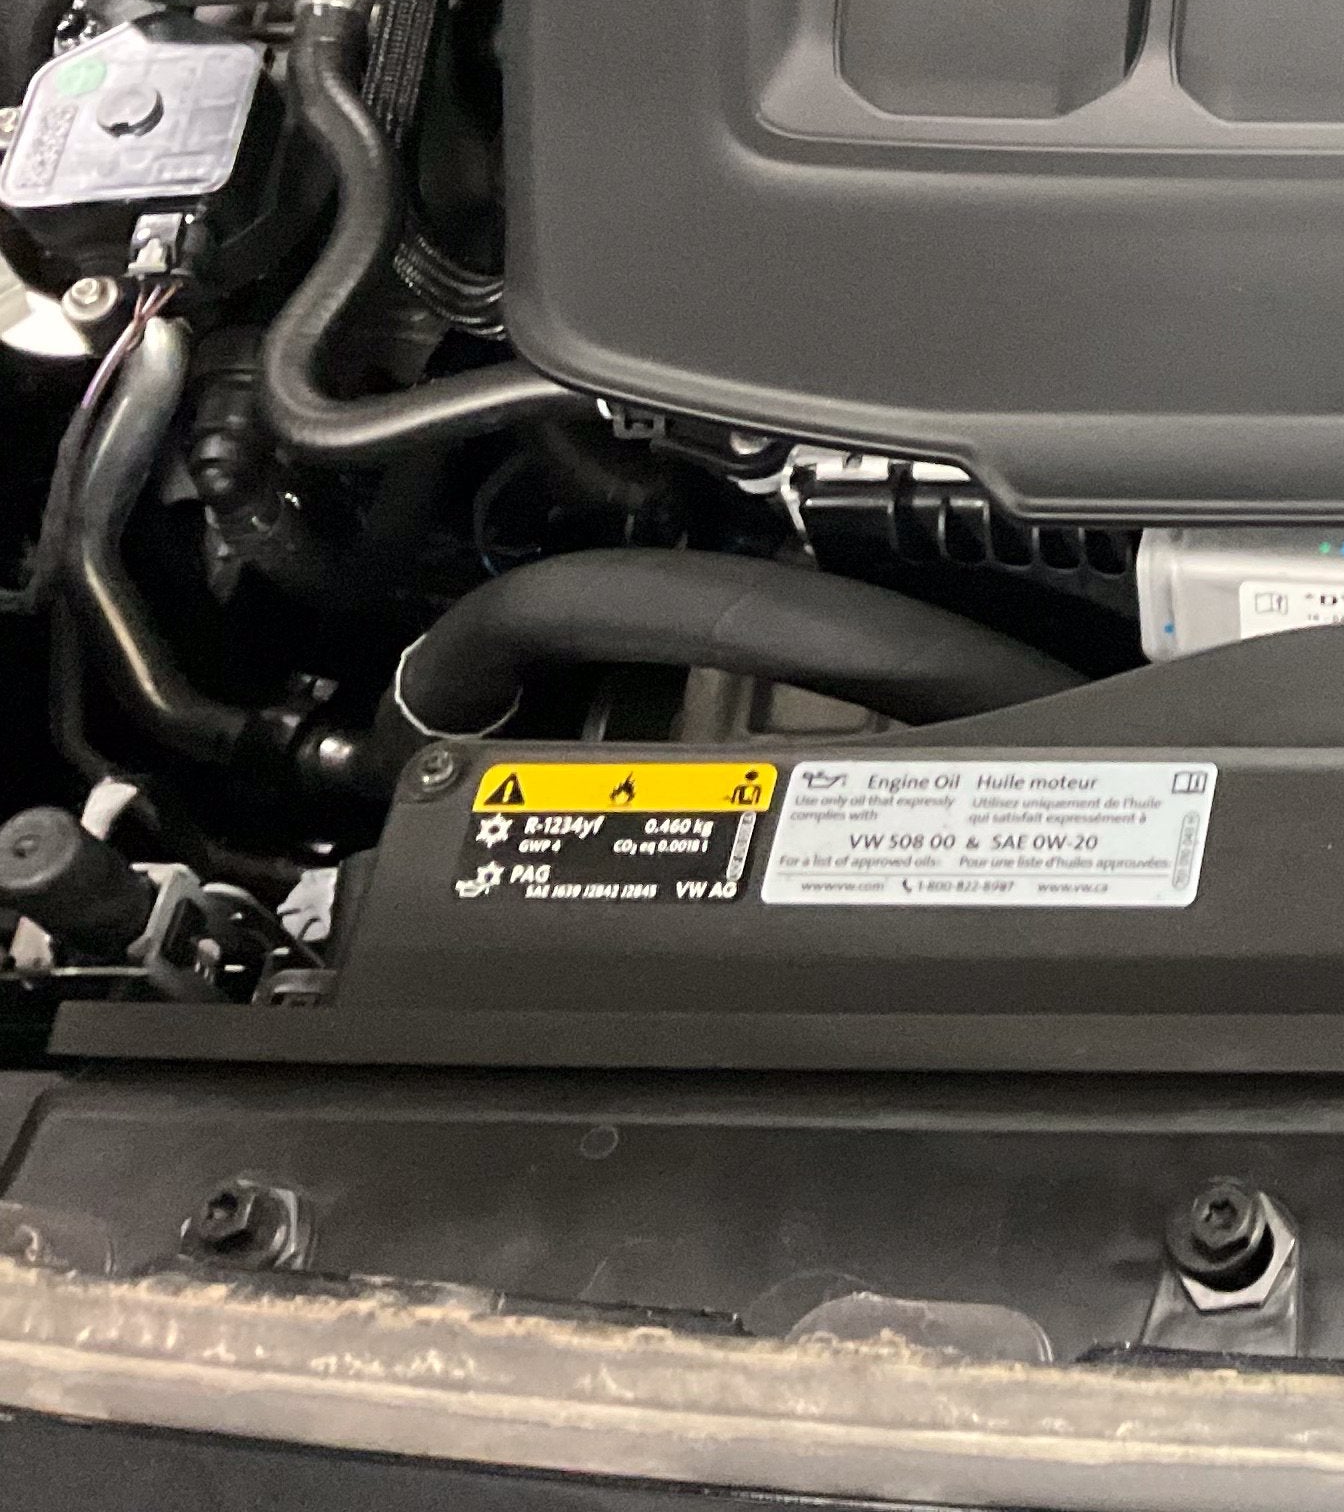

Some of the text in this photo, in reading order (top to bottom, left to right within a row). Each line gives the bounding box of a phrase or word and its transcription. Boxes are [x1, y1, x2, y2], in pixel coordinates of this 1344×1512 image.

[868, 774, 1098, 793] Engine Oil Huile moteur
[795, 795, 955, 809] Use only oil that expressly
[1022, 798, 1100, 812] uniquement
[1104, 797, 1120, 809] de
[1123, 797, 1161, 809] l'huile
[790, 810, 877, 823] complies with
[969, 813, 989, 825] qui
[992, 812, 1042, 823] satisfait
[1046, 813, 1135, 825] expressément
[524, 815, 605, 840] R-1234yf
[693, 818, 714, 838] kg
[519, 839, 551, 853] GWP
[850, 833, 1098, 850] VW 508 00 & SAE 0W-20
[779, 854, 799, 866] For
[802, 857, 810, 866] a
[813, 854, 832, 866] list
[835, 854, 849, 866] of
[851, 854, 911, 869] approved
[960, 856, 988, 867] Pour
[991, 858, 1014, 867] une
[1017, 856, 1043, 867] liste
[1045, 855, 1093, 867] d'huiles
[510, 864, 551, 883] PAG
[676, 881, 708, 899] VW
[708, 881, 737, 899] AG
